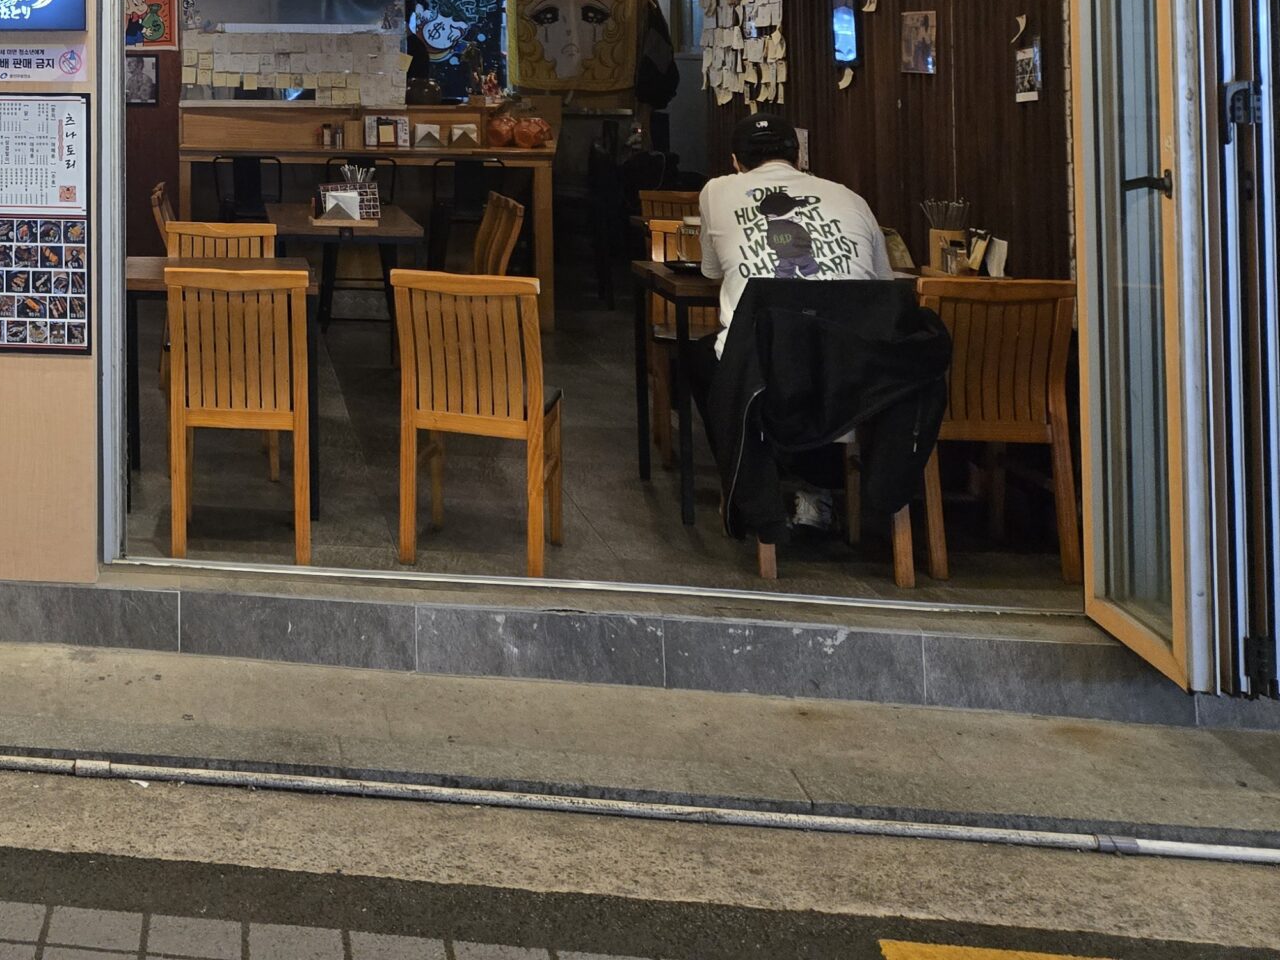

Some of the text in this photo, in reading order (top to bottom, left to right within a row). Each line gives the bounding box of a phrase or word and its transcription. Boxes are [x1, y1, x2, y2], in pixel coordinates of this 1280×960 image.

[13, 58, 32, 69] 판매
[35, 58, 55, 69] 금지
[64, 113, 77, 170] 츠나토리
